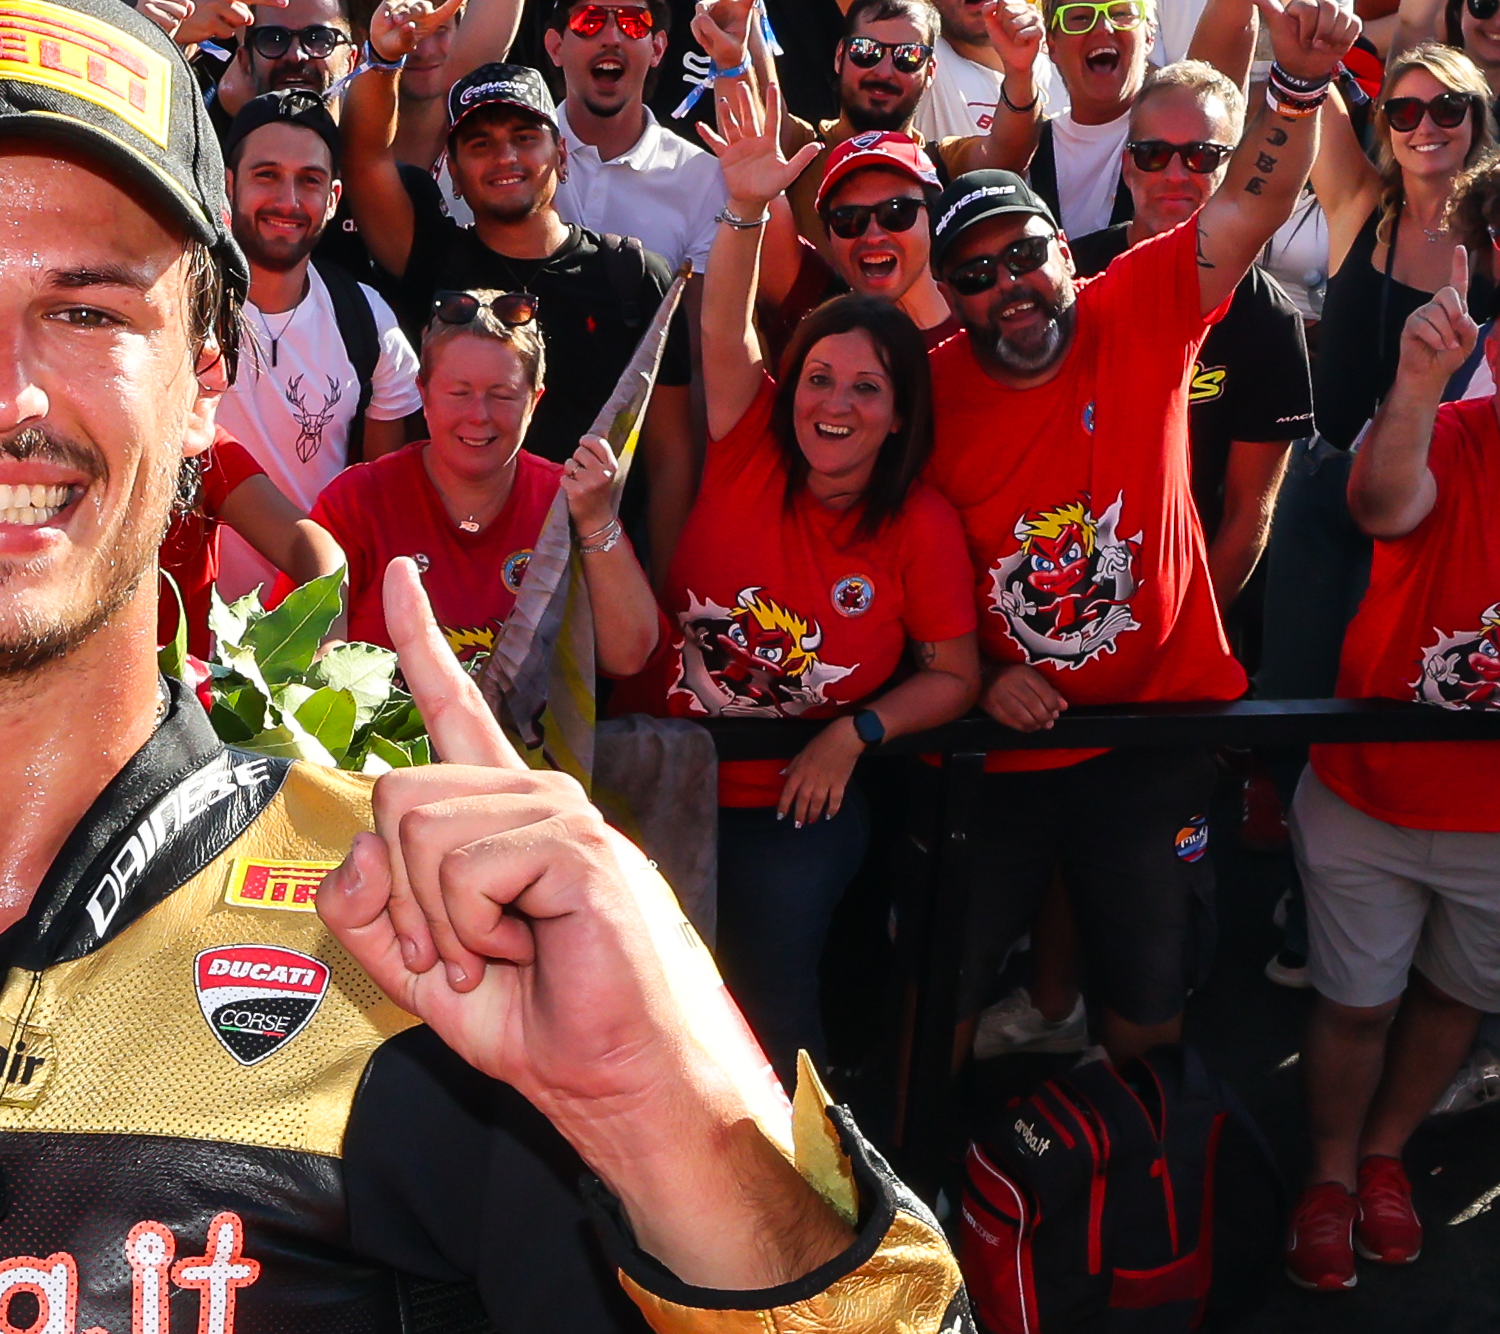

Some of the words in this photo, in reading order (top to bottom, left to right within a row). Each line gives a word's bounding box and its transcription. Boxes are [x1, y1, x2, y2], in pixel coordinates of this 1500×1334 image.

[936, 184, 1017, 236] alpinestars
[85, 757, 272, 938] DAINESE
[206, 956, 319, 988] DUCATI
[219, 1008, 291, 1036] CORSE
